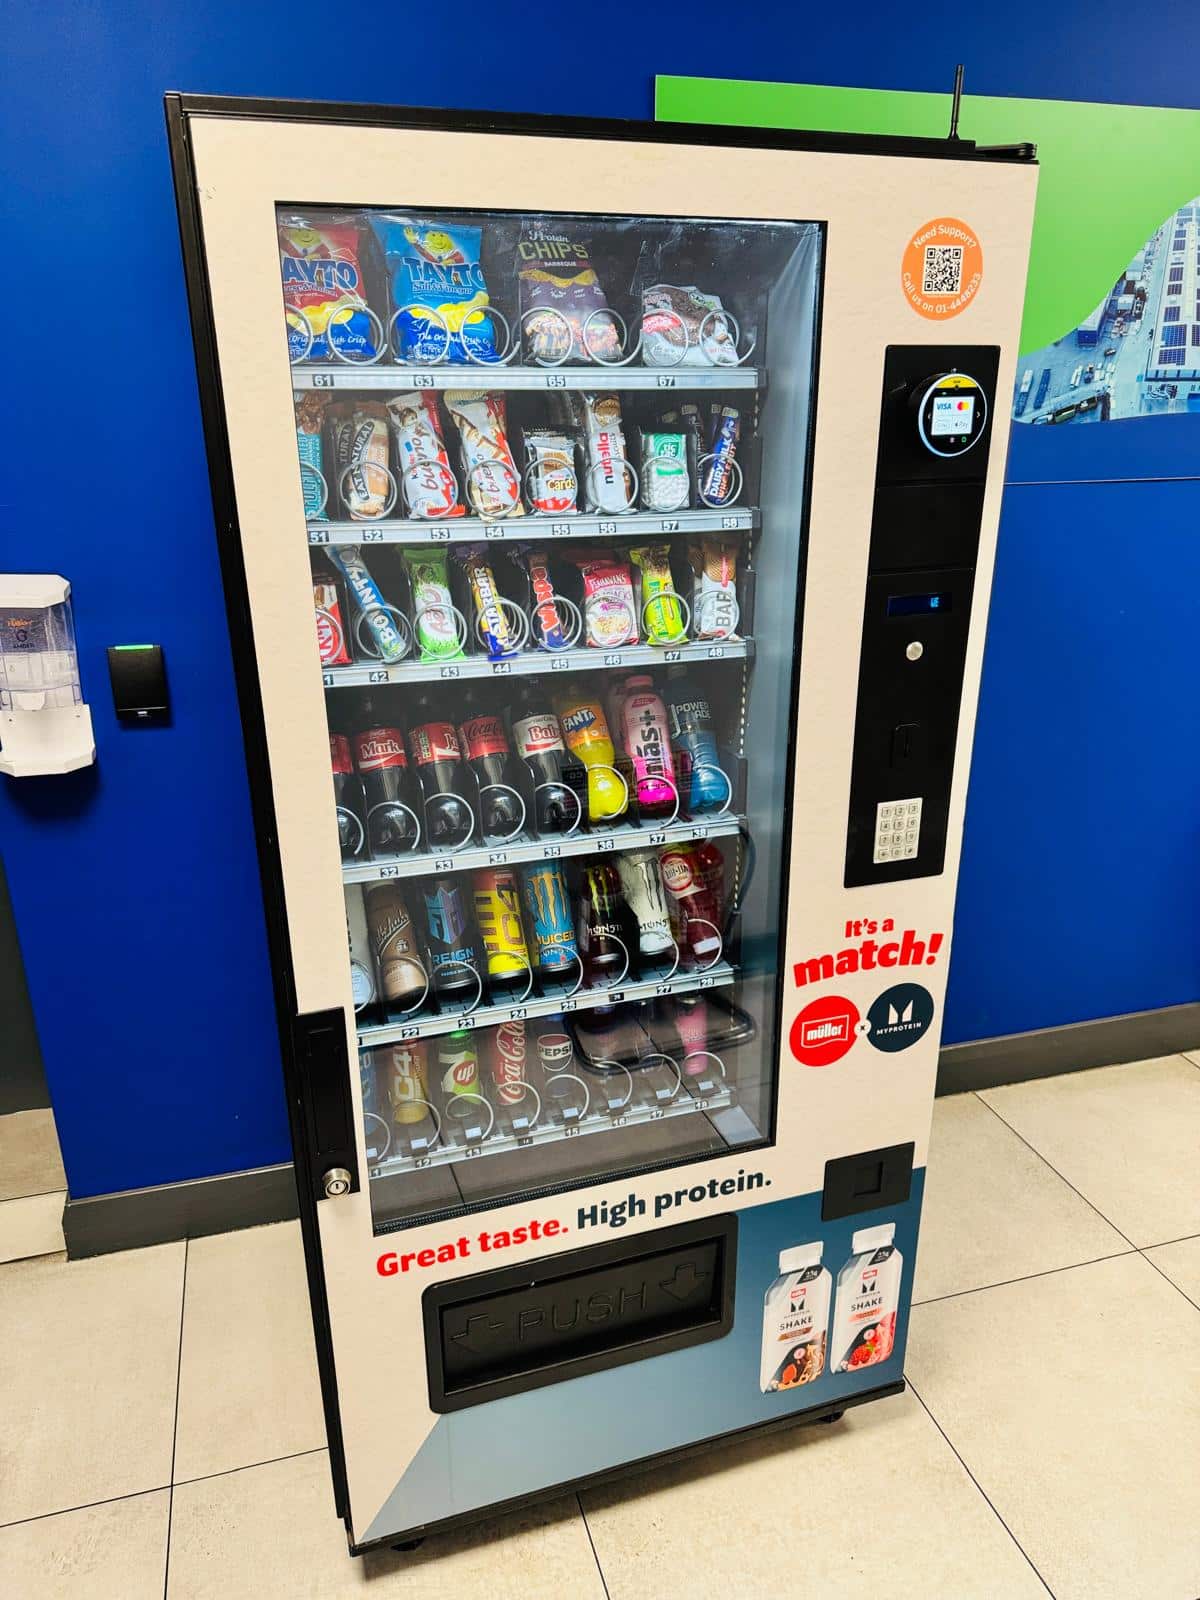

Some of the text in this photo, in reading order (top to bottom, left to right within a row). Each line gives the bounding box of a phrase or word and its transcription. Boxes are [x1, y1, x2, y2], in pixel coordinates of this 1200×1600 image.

[913, 224, 978, 249] Need Support?
[516, 240, 590, 261] CHIPS
[281, 255, 358, 290] AYTO
[402, 256, 488, 289] TAYTO
[903, 272, 916, 294] Call
[911, 294, 923, 306] us
[922, 303, 934, 313] on
[314, 375, 333, 387] 61
[414, 375, 433, 387] 63
[548, 376, 565, 387] 65
[658, 376, 674, 387] 67
[936, 402, 952, 411] VISA
[597, 432, 614, 485] nutella
[546, 477, 576, 491] Cards
[709, 465, 725, 497] DAIRY
[354, 477, 370, 500] EAT
[599, 522, 616, 533] 56
[663, 520, 679, 531] 57
[722, 518, 738, 529] 58
[432, 528, 449, 539] 53
[486, 527, 503, 538] 54
[553, 524, 570, 535] 55
[309, 531, 328, 543] 51
[364, 530, 383, 541] 52
[665, 651, 680, 661] 47
[708, 648, 724, 657] 48
[552, 659, 568, 669] 45
[605, 655, 620, 666] 46
[442, 667, 458, 677] 43
[494, 664, 510, 673] 44
[371, 672, 388, 682] 42
[562, 707, 597, 732] FANTA
[360, 739, 402, 760] Mark
[650, 834, 666, 844] 37
[693, 829, 708, 838] 38
[598, 841, 614, 850] 36
[436, 860, 453, 870] 33
[381, 867, 398, 877] 32
[844, 917, 895, 939] It's a
[431, 946, 476, 965] REIGN
[792, 929, 945, 989] match!
[700, 978, 715, 987] 28
[656, 985, 672, 994] 27
[511, 1010, 527, 1019] 24
[459, 1019, 475, 1028] 23
[403, 1029, 420, 1038] 22
[806, 1022, 844, 1042] müller
[875, 1021, 923, 1036] MYPROTEIN
[651, 1110, 664, 1118] 17
[612, 1117, 626, 1126] 16
[565, 1127, 579, 1137] 15
[466, 1148, 481, 1157] 13
[416, 1159, 431, 1167] 12
[375, 1168, 773, 1278] Great taste. High protein.
[850, 1295, 884, 1312] SHAKE
[517, 1281, 648, 1342] PUSH
[779, 1315, 814, 1332] SHAKE
